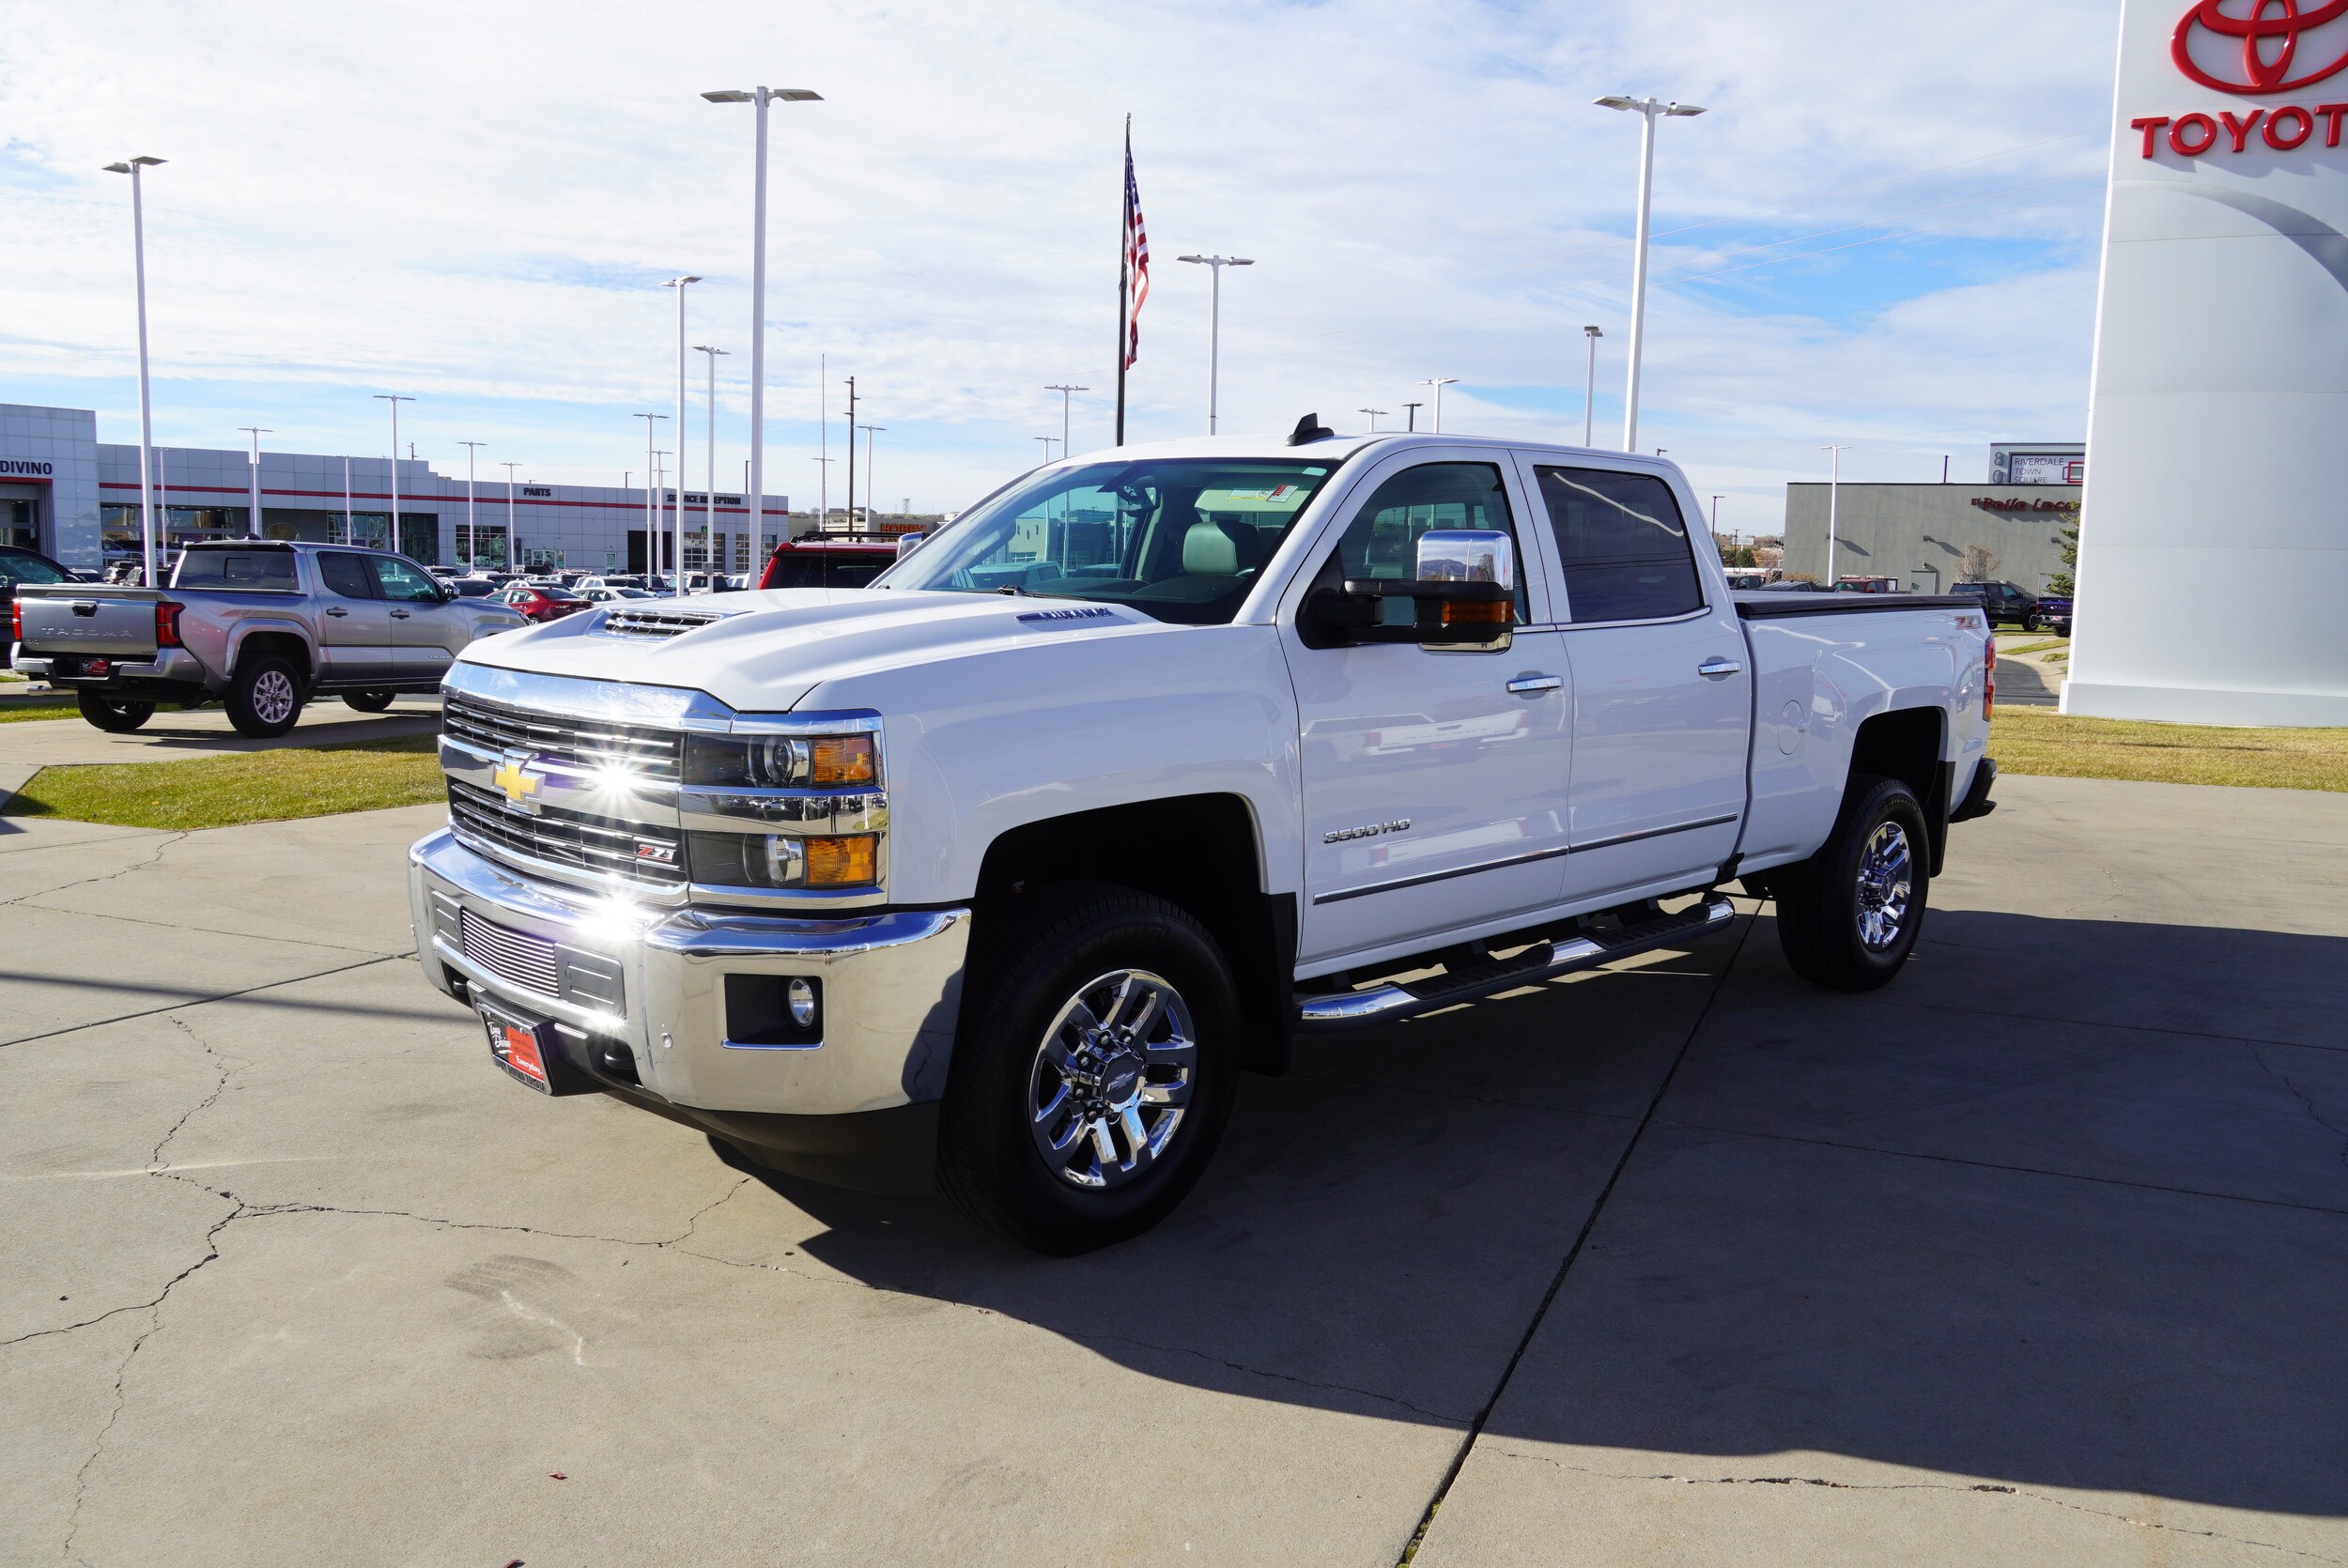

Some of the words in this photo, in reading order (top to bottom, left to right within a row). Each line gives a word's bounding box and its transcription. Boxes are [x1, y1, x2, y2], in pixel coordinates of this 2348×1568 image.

[2130, 103, 2348, 159] TOYOT
[0, 460, 53, 475] DIVINO
[2015, 457, 2064, 466] RIVERDALE
[523, 487, 551, 497] PARTS
[667, 494, 699, 503] SEVICE
[700, 495, 741, 505] REEPTION
[1982, 497, 2028, 512] Pollo
[880, 522, 926, 533] HOBBY
[1041, 607, 1114, 621] DURAMAX
[1954, 615, 1983, 630] Z71
[41, 627, 133, 638] TACOMA
[1382, 818, 1411, 834] HD
[638, 843, 677, 863] Z71
